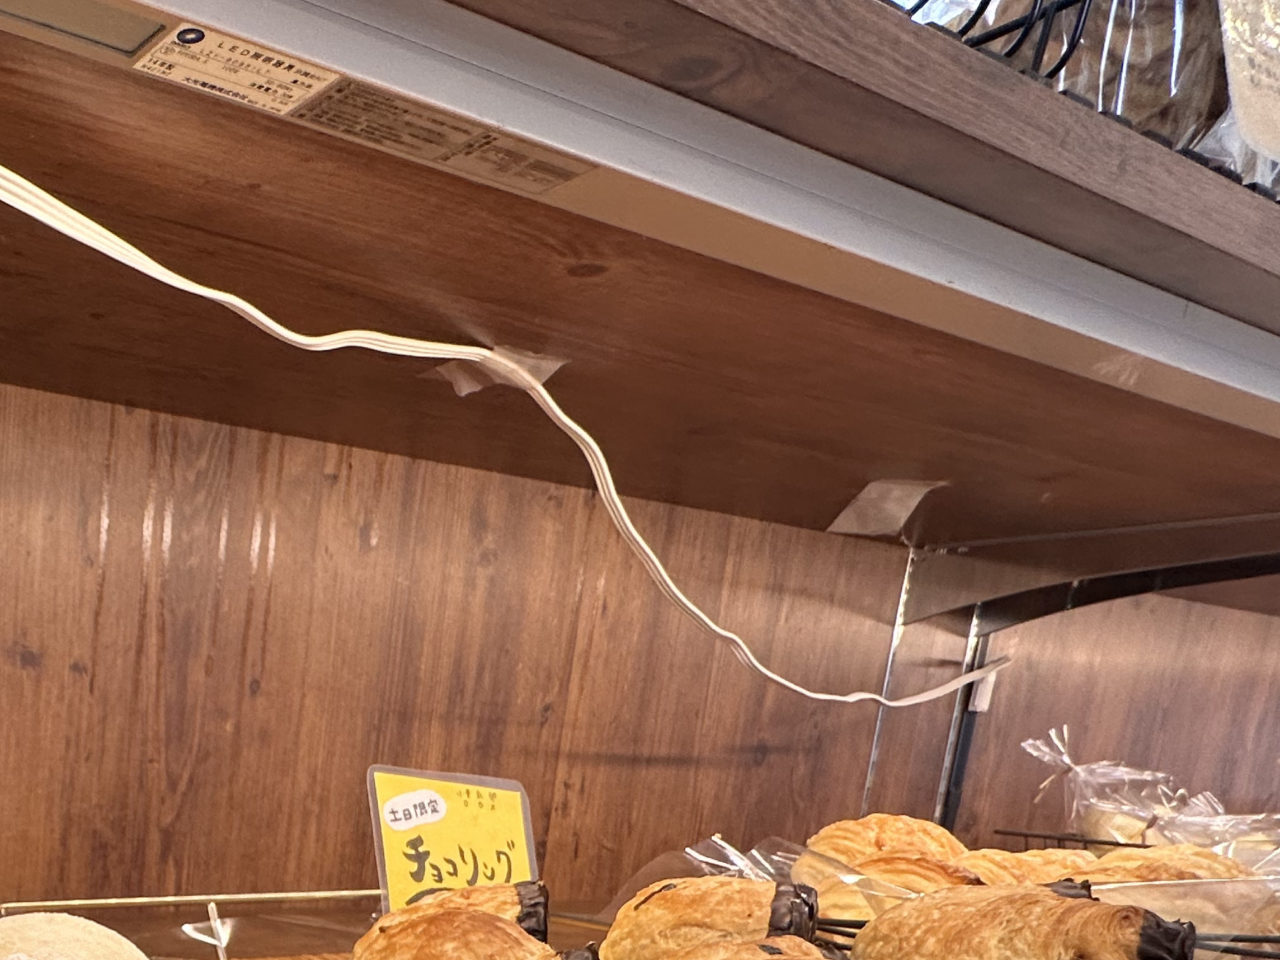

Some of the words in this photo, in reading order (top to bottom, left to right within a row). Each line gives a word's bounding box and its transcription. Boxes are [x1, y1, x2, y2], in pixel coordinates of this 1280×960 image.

[388, 798, 440, 823] 土日限定
[402, 834, 515, 886] チョコリング
